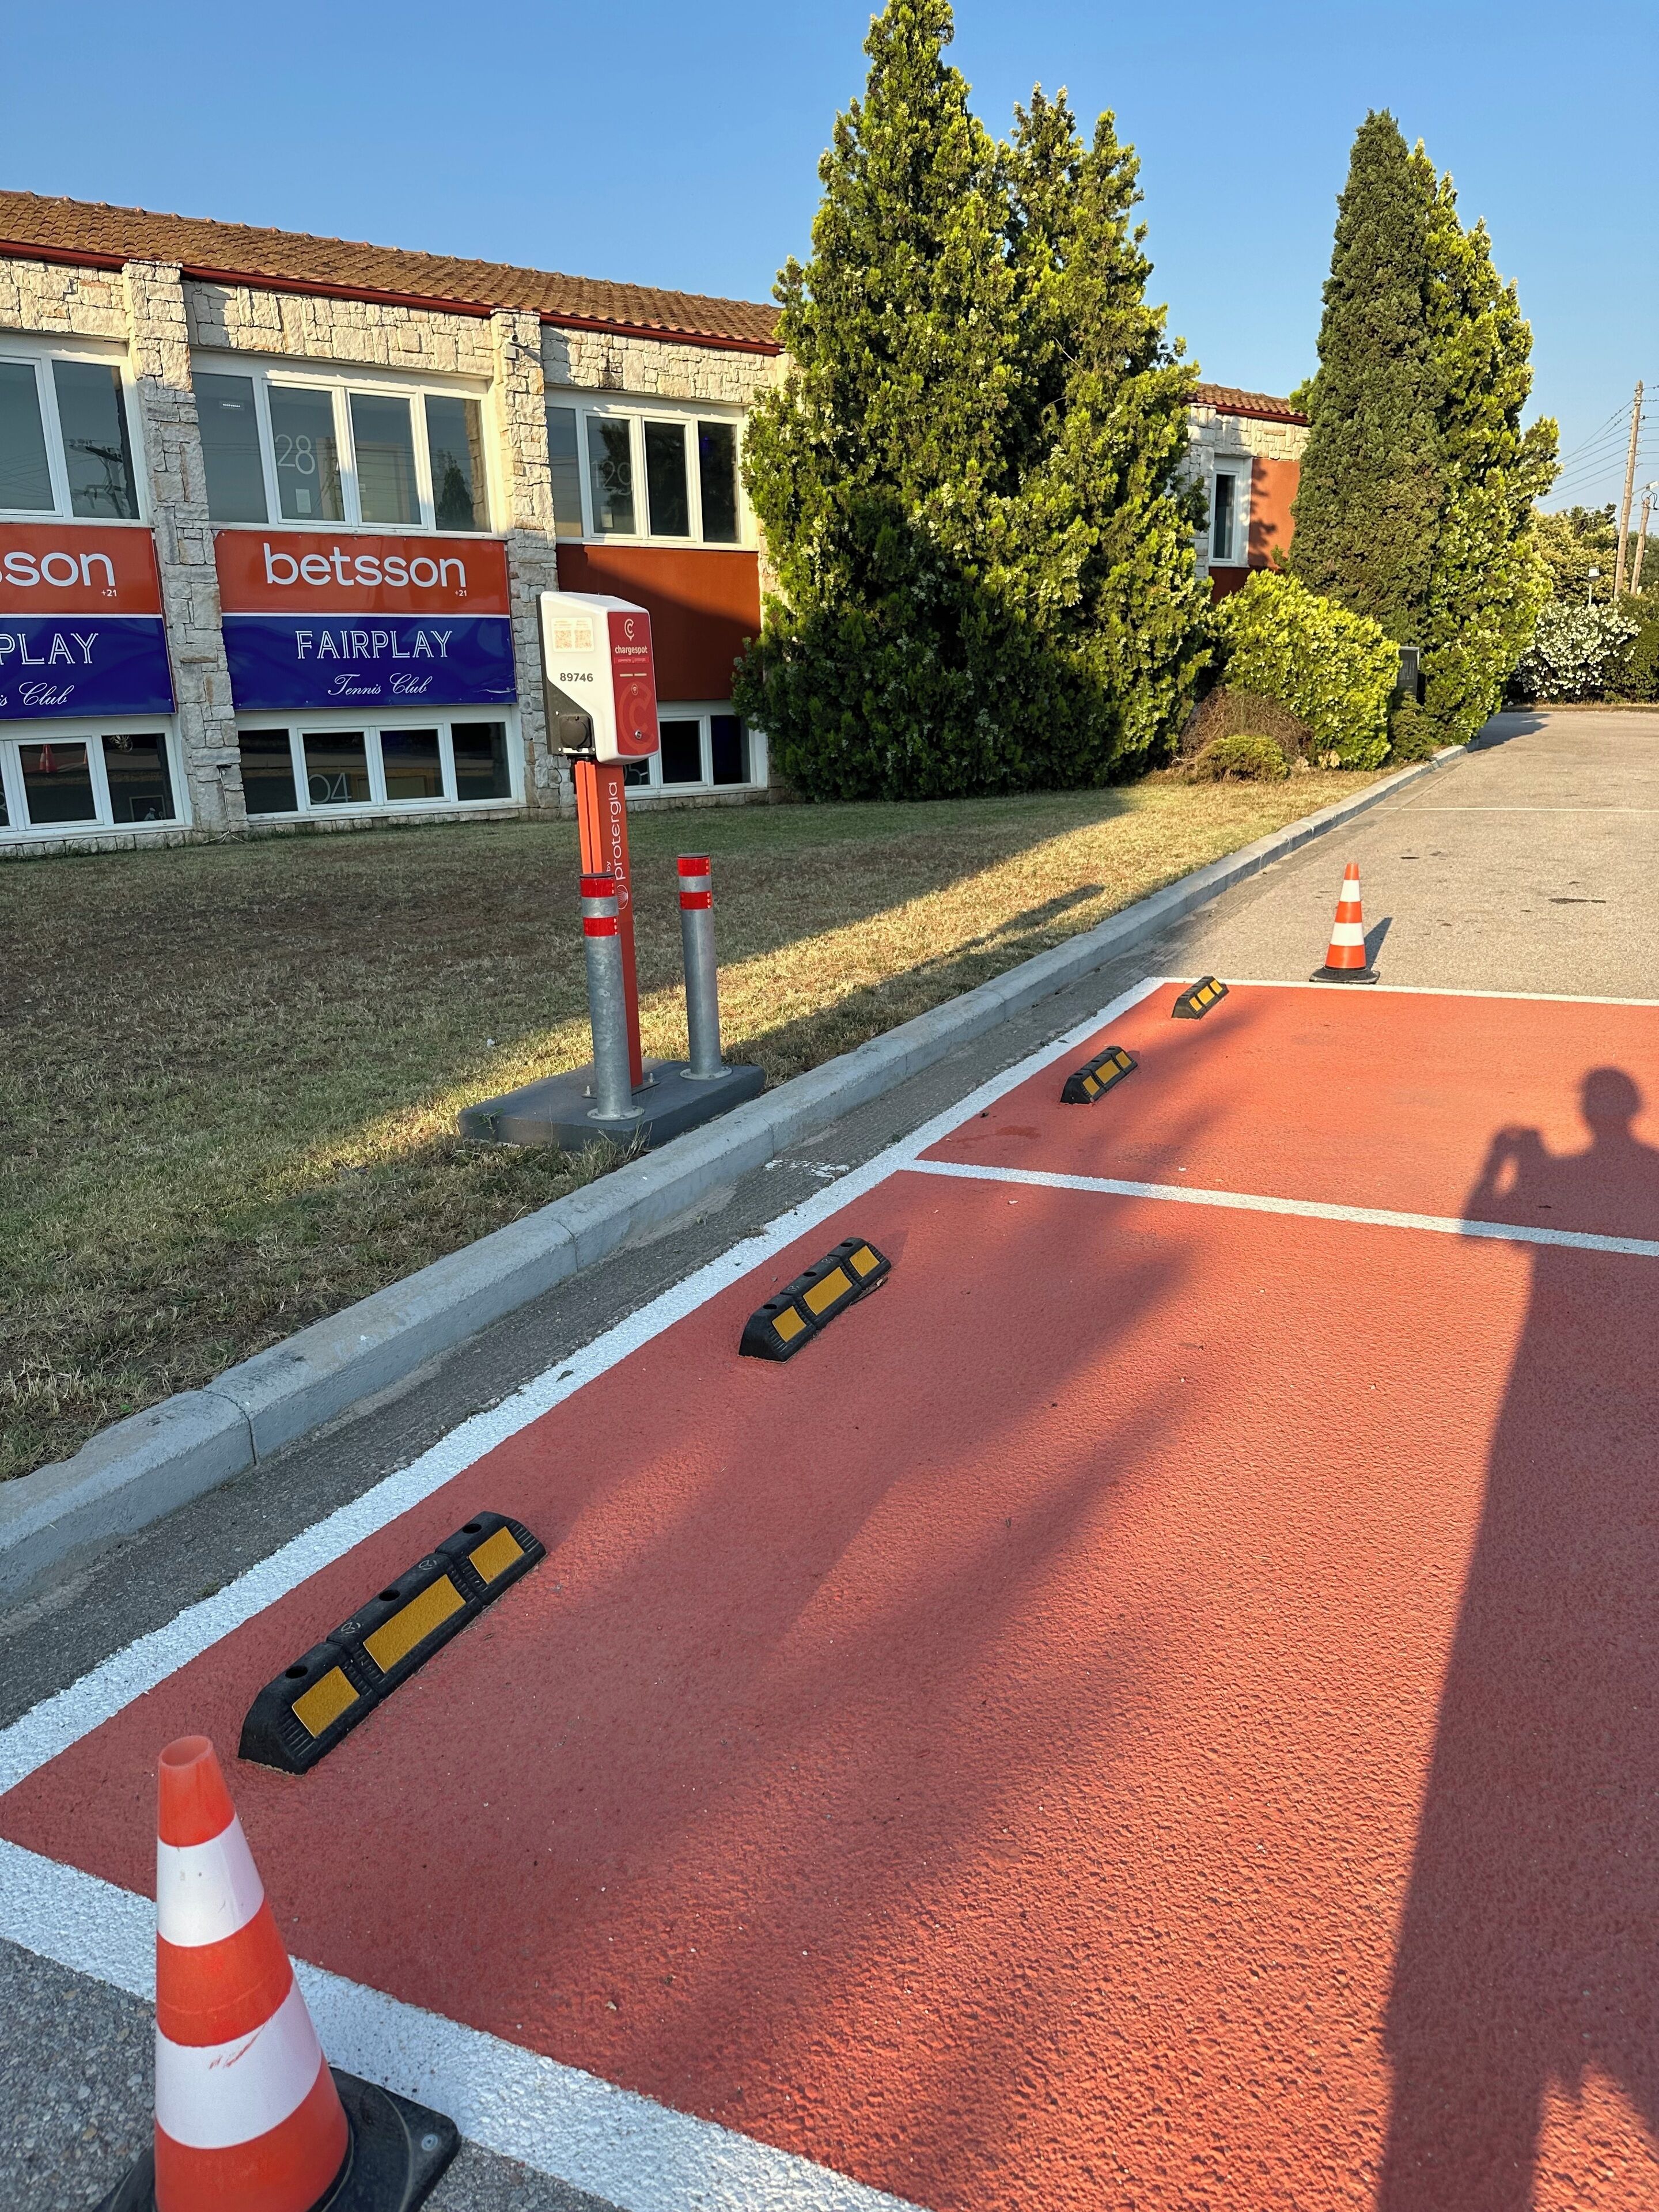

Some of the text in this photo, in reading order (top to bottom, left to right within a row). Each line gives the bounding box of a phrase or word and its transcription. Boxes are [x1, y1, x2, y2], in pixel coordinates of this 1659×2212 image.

[275, 434, 315, 475] 28
[0, 551, 116, 587] son
[263, 543, 467, 588] betsson
[101, 589, 118, 597] +21
[454, 589, 468, 597] +21
[295, 630, 453, 660] FAIRPLAY
[615, 645, 648, 656] chargespot
[327, 672, 433, 695] Tennis Club
[559, 672, 594, 683] 89746
[18, 681, 75, 706] Club
[607, 781, 626, 880] by protergia
